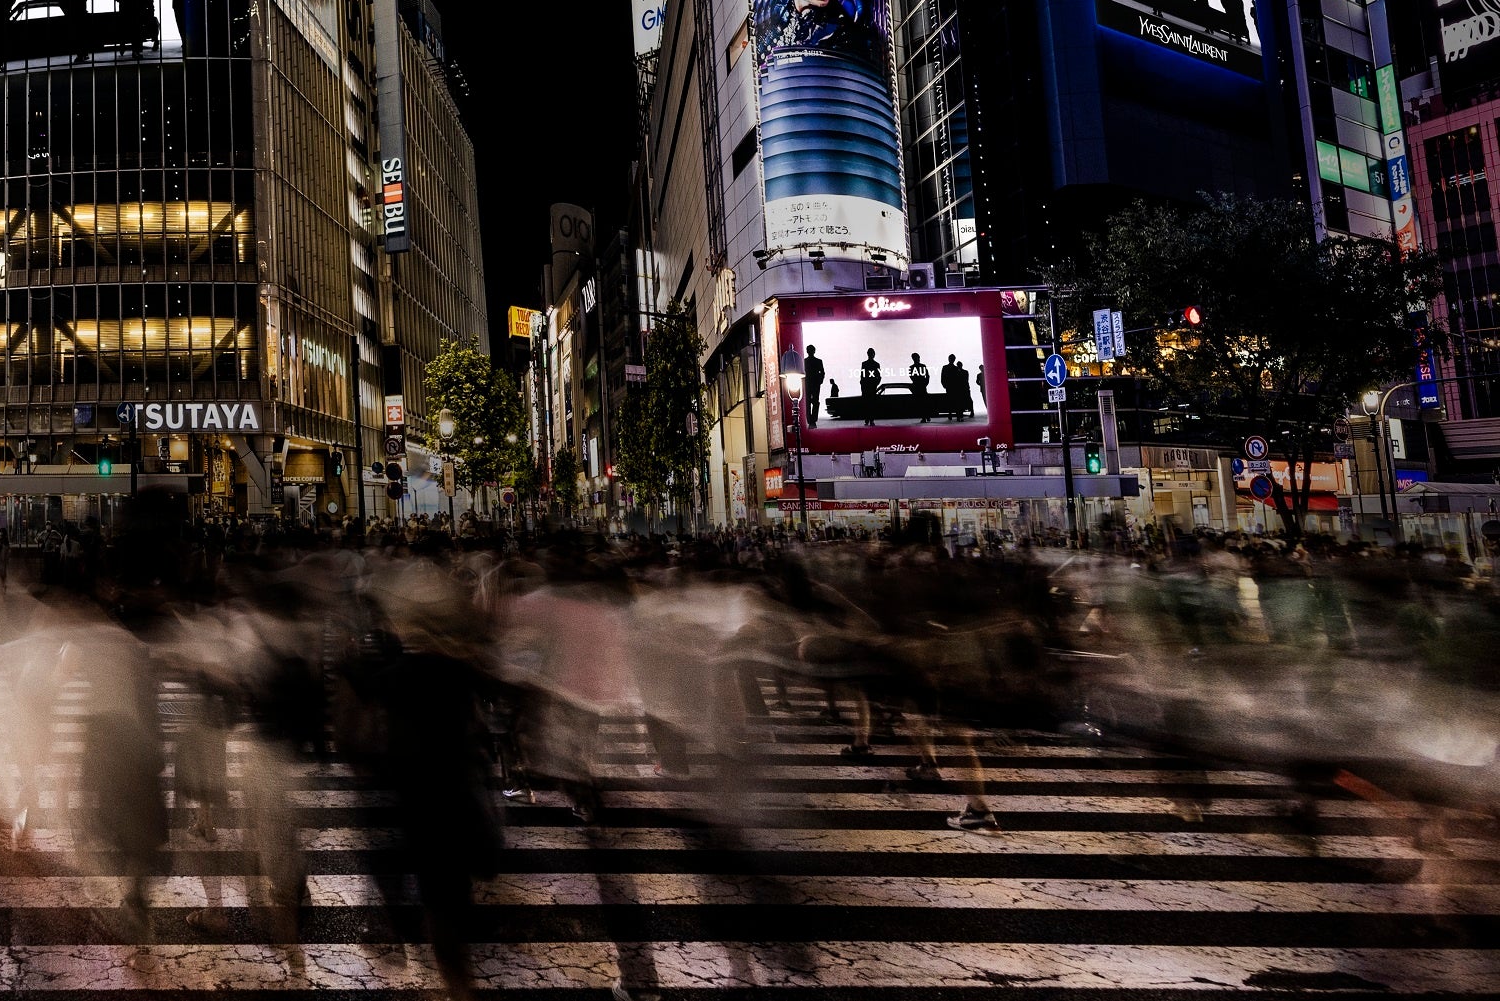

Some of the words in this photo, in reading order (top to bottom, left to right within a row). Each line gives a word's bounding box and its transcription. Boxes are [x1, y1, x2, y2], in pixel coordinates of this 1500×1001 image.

[1373, 170, 1385, 185] 5F
[381, 156, 406, 236] SEIBU
[864, 296, 912, 318] Glico
[848, 368, 866, 379] JO1
[868, 369, 876, 379] x
[877, 366, 897, 378] YSL
[899, 365, 940, 378] BEAUTY
[134, 402, 260, 430] TSUTAYA
[1163, 448, 1199, 465] MAGNET
[781, 501, 822, 511] SANENRI
